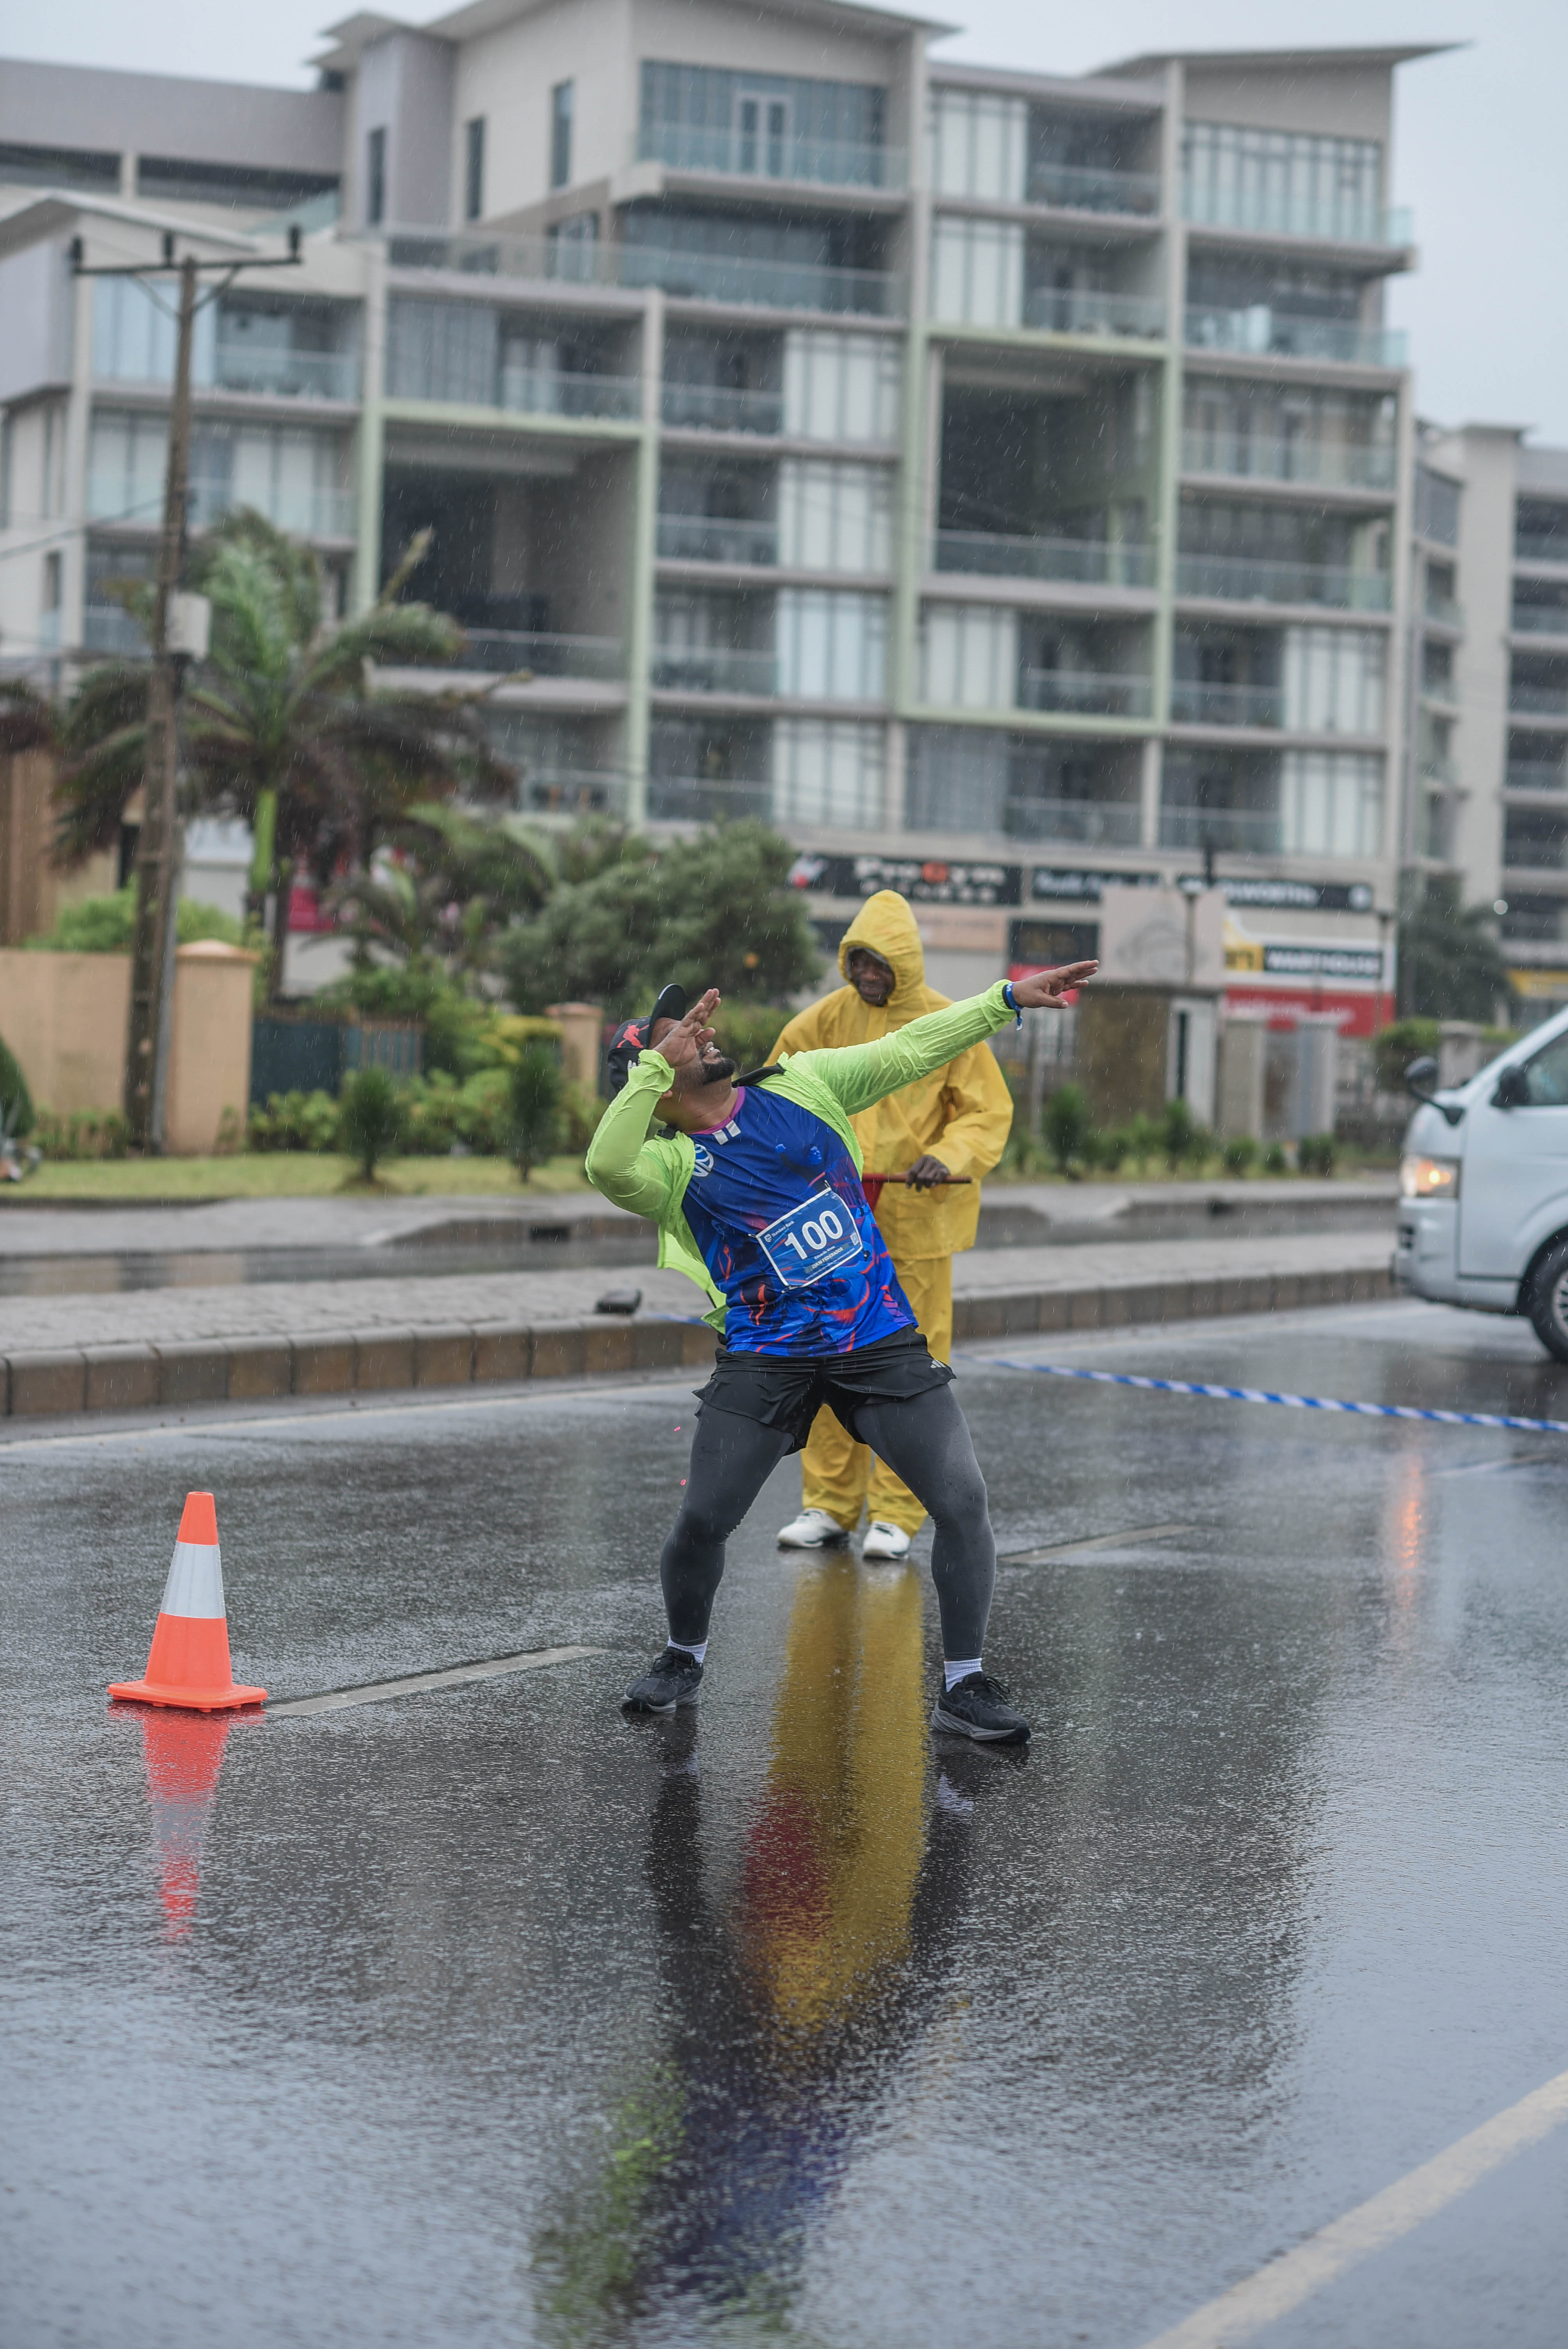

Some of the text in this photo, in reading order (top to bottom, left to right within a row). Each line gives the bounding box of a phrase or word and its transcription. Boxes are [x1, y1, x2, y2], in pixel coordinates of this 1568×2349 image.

[772, 1225, 786, 1237] Standard
[784, 1210, 843, 1260] 100
[821, 1247, 843, 1262] FEDERADOS
